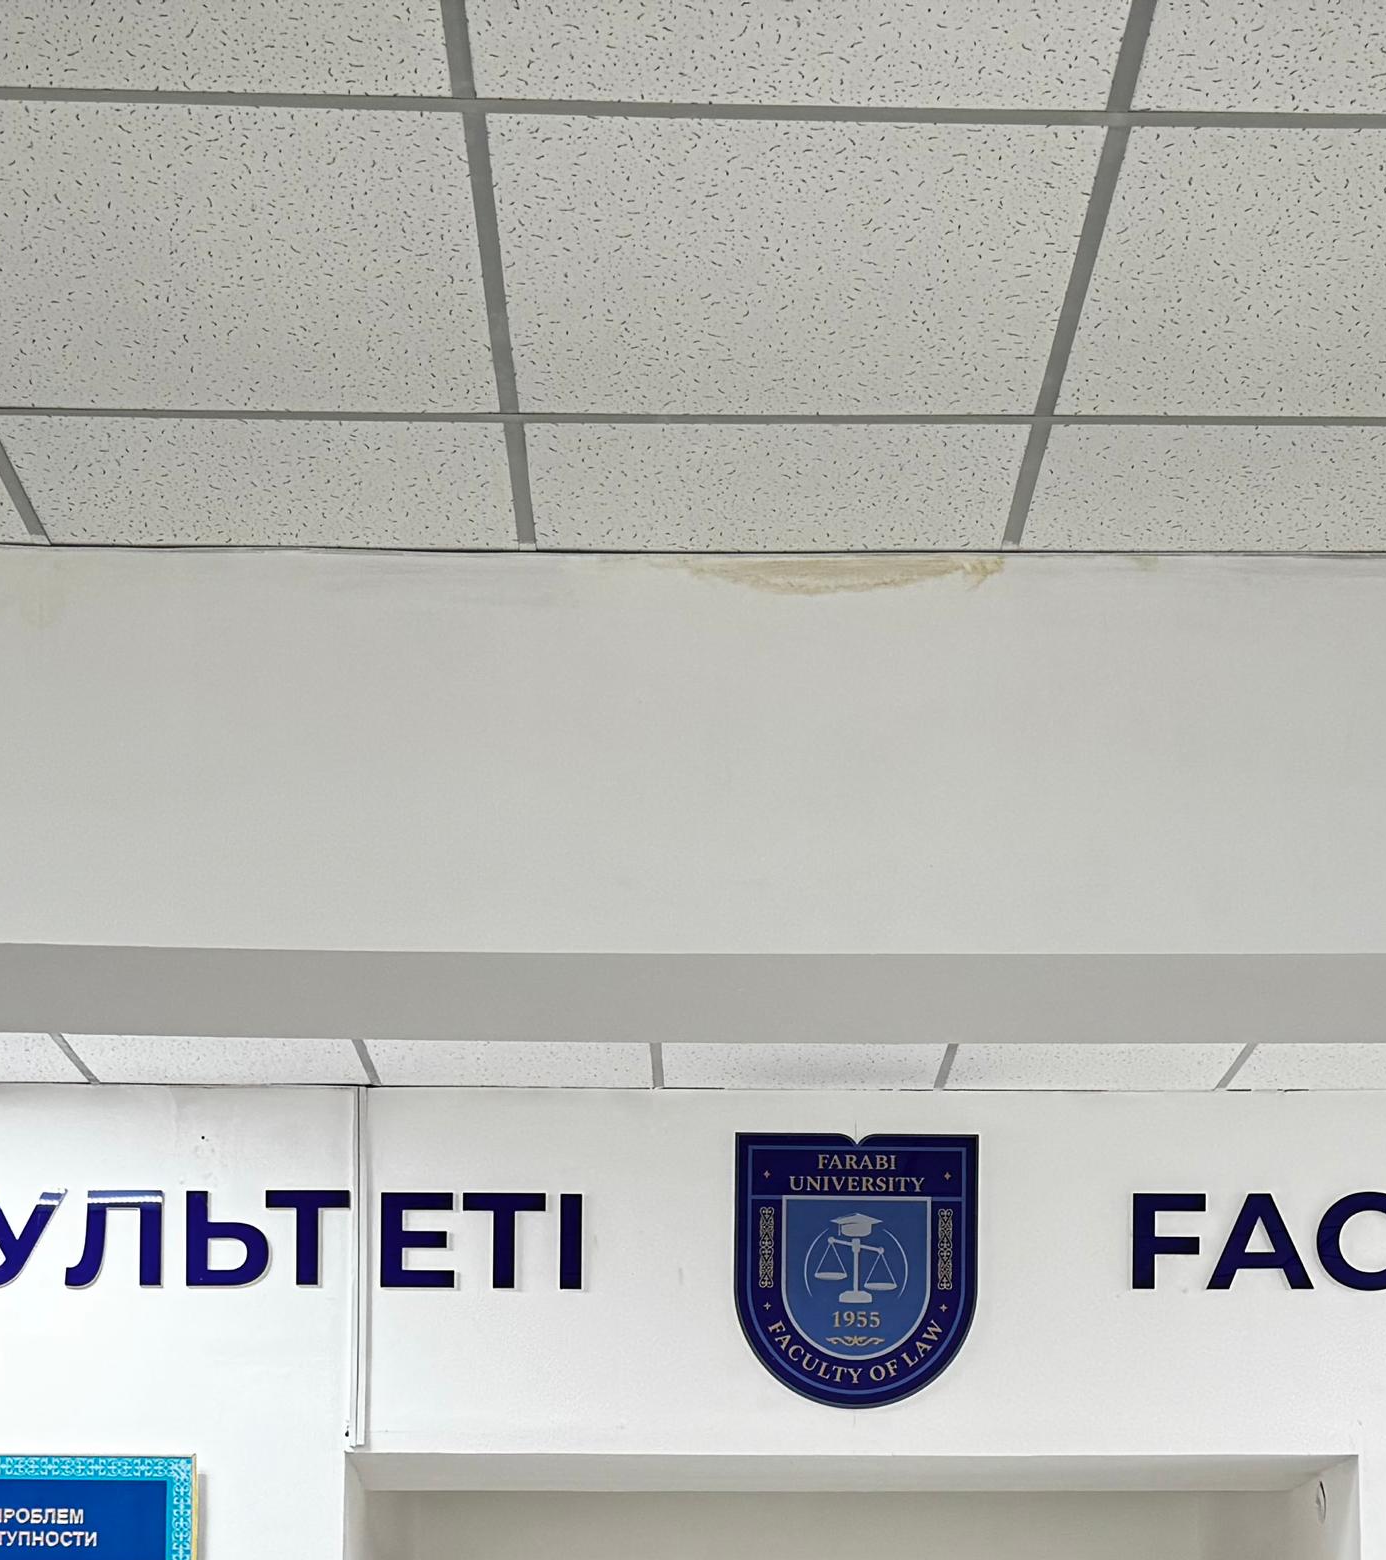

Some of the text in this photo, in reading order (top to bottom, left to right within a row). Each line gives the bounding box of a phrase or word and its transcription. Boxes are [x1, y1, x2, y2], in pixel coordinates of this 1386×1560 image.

[817, 1154, 897, 1170] FARABI
[789, 1175, 926, 1193] UNIVERSITY
[831, 1311, 881, 1329] 1955
[768, 1319, 944, 1385] FACULTY OF LAW
